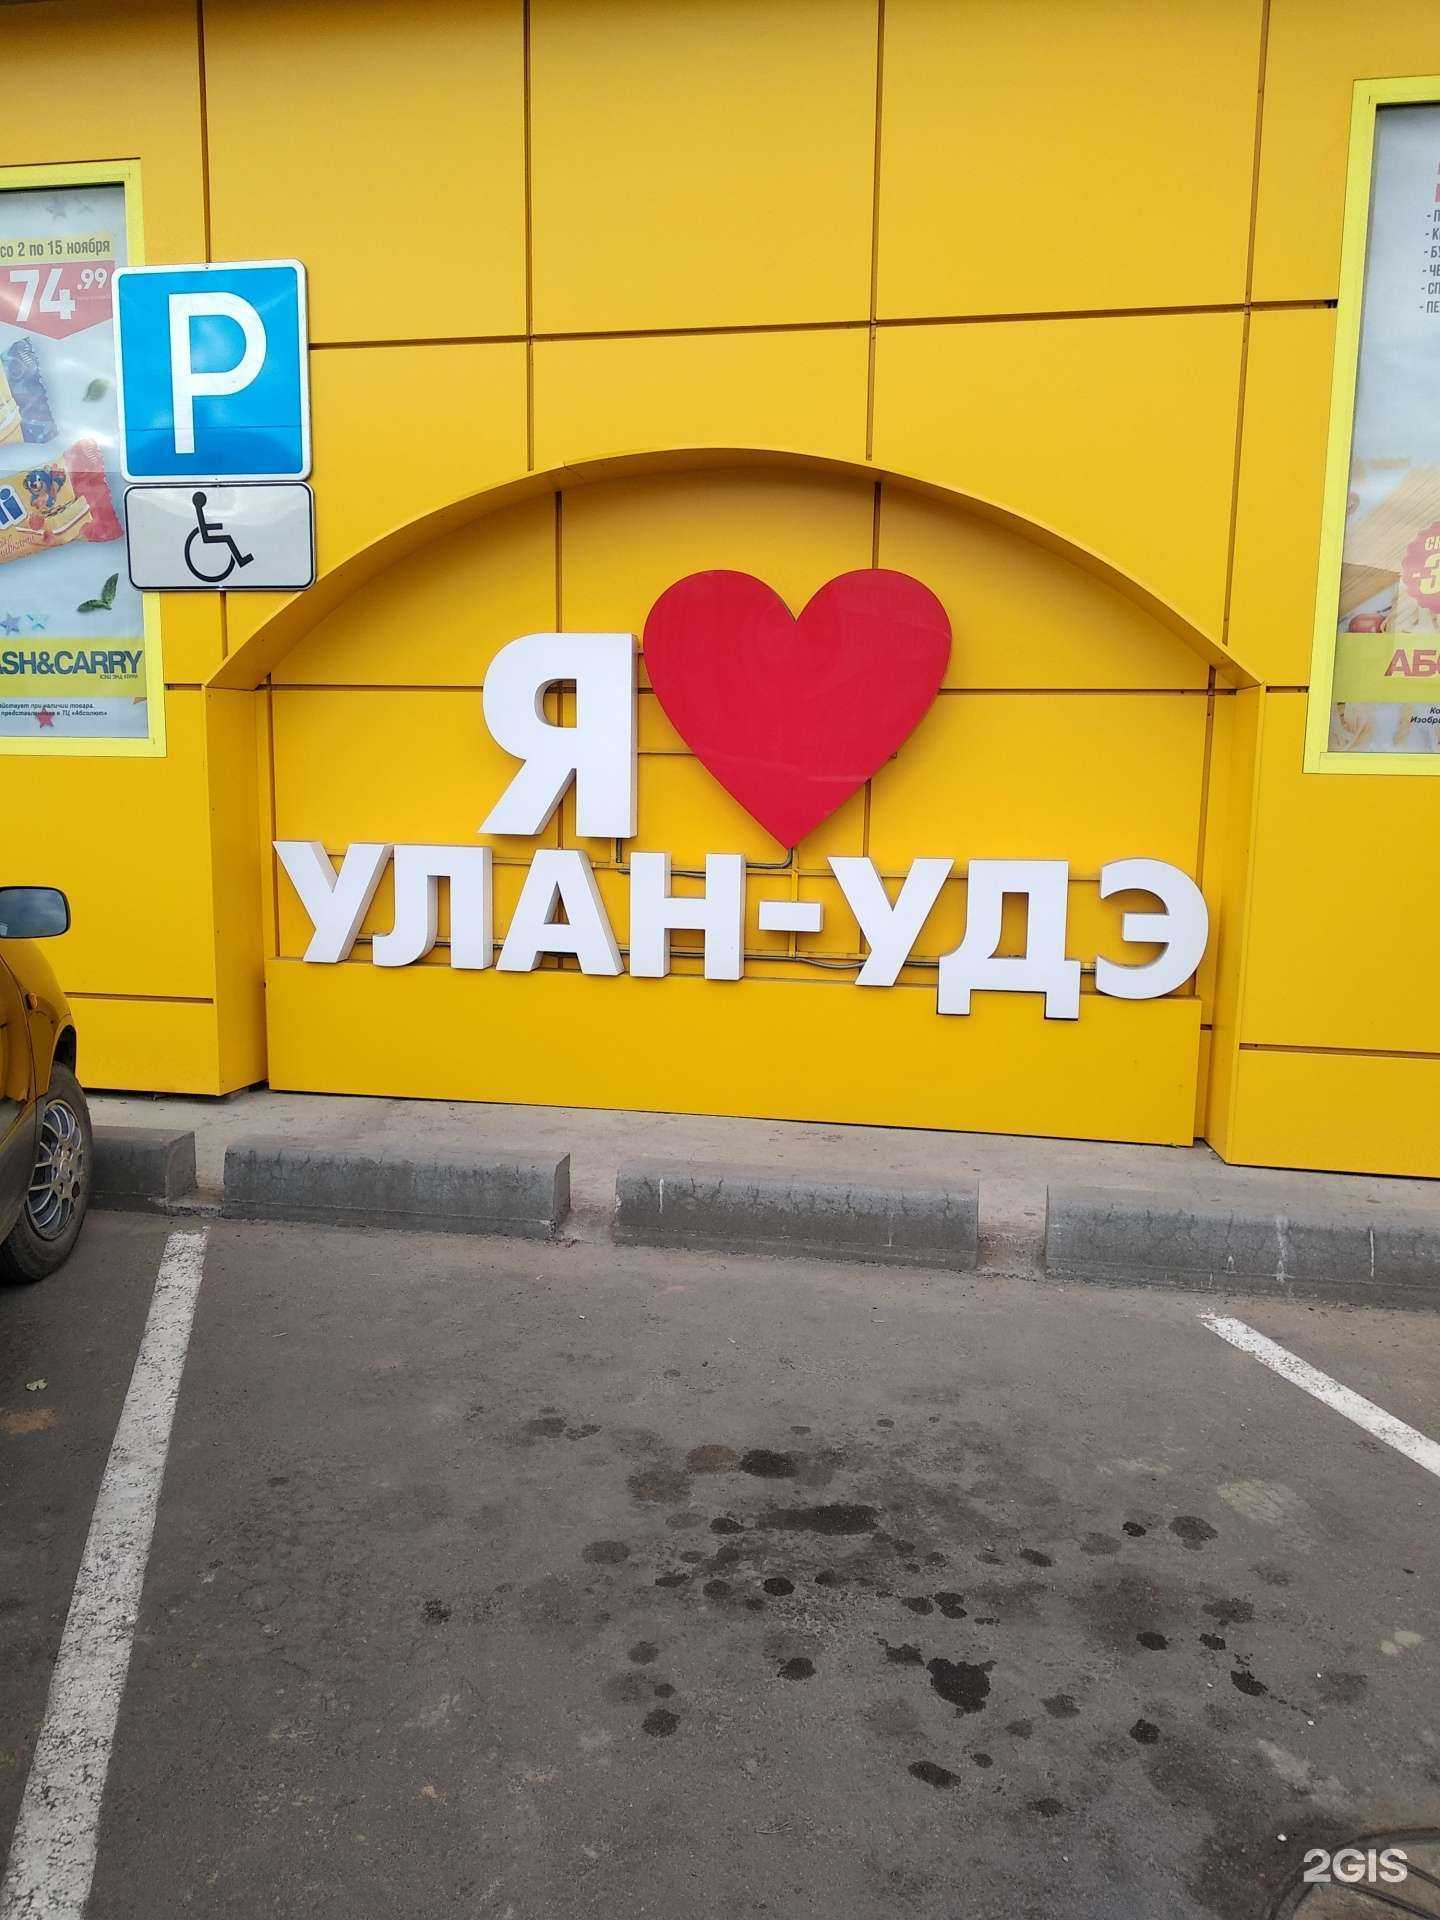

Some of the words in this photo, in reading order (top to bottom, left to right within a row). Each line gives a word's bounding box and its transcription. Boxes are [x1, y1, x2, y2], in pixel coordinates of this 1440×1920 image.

[0, 245, 14, 258] со
[18, 242, 25, 256] 2
[30, 243, 44, 256] по
[48, 240, 62, 255] 15
[67, 237, 110, 256] ноября
[168, 291, 267, 454] P
[0, 650, 143, 675] SH&CARRY
[1384, 649, 1440, 677] АБ
[1410, 715, 1440, 726] Изобр
[479, 632, 639, 839] Я
[273, 840, 1210, 1021] УЛАН-УДЭ
